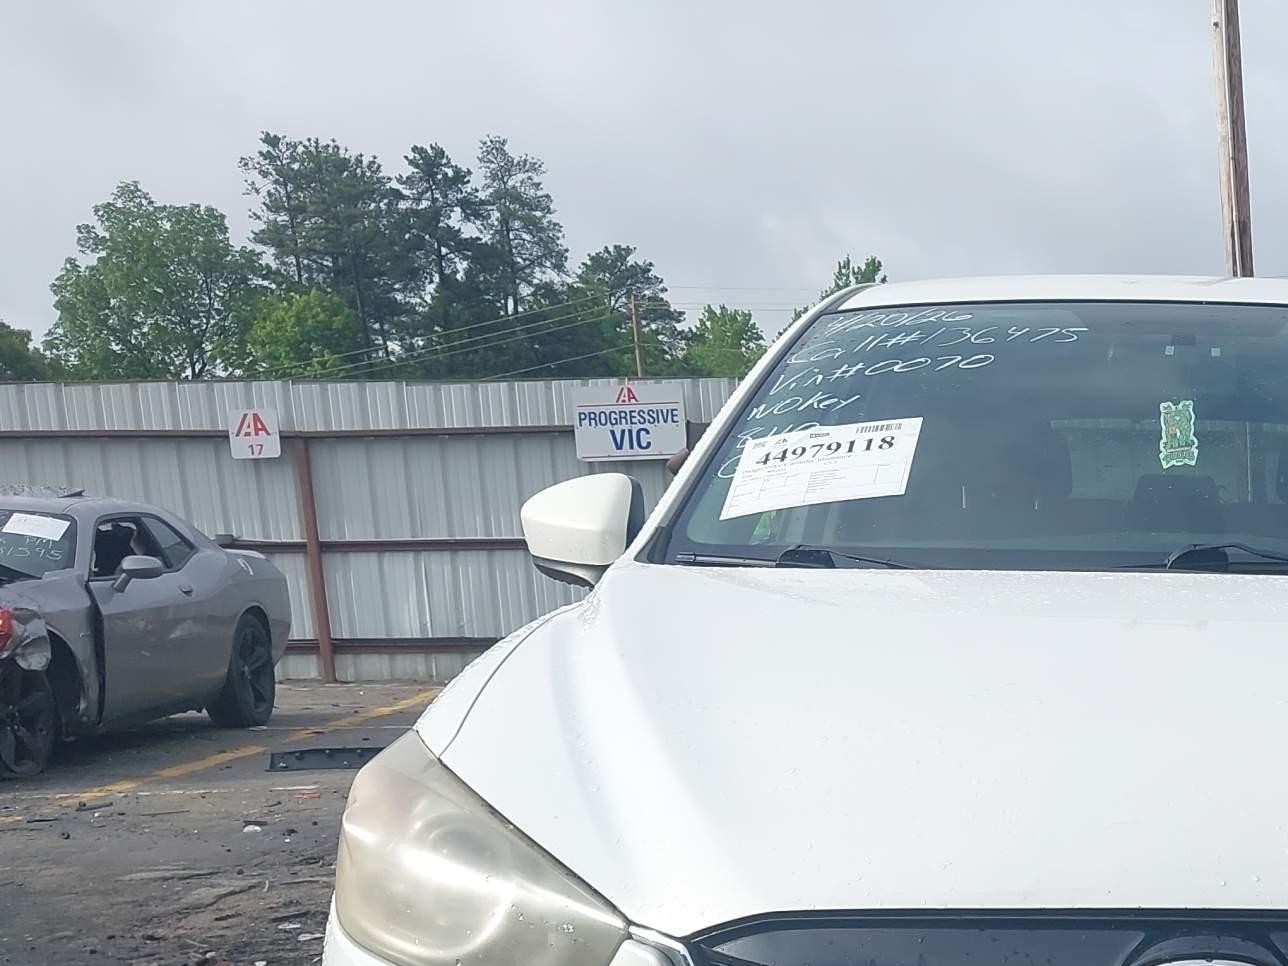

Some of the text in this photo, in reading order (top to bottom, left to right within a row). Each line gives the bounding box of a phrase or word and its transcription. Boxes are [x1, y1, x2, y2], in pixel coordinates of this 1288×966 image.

[578, 408, 680, 427] PROGRESSIVE
[610, 427, 652, 451] VIC
[248, 443, 264, 457] 17
[755, 435, 896, 466] 44979118
